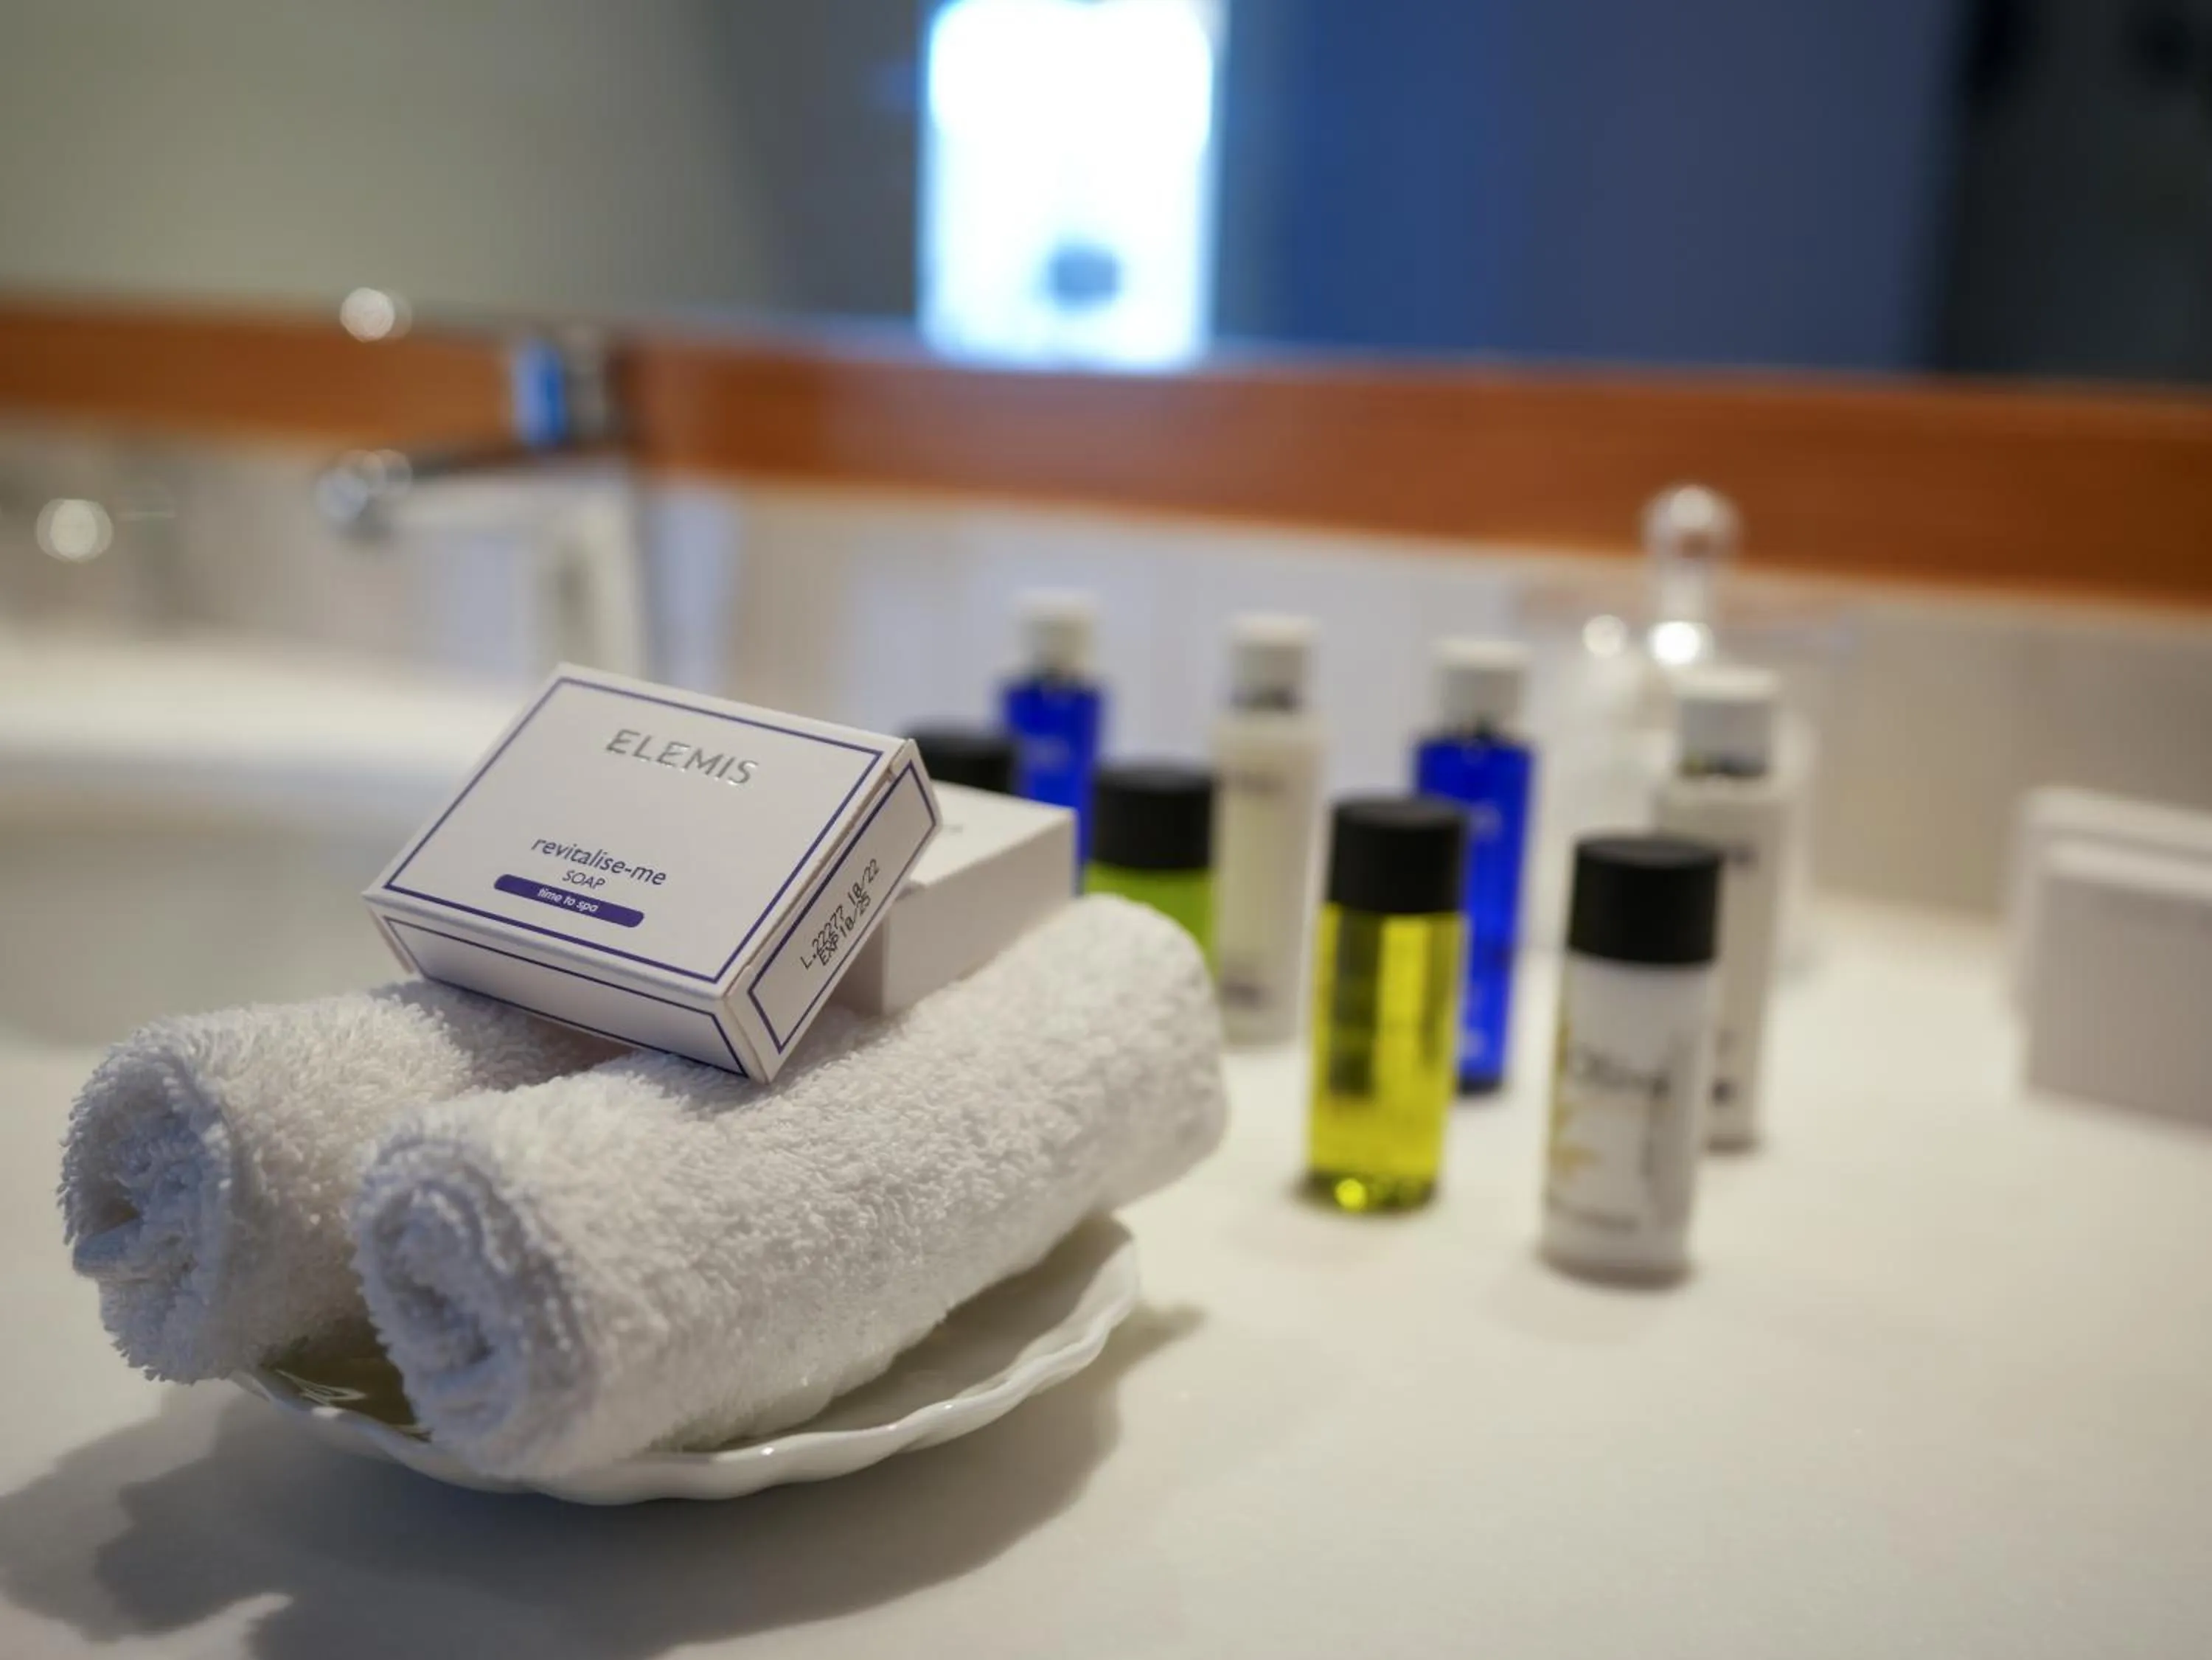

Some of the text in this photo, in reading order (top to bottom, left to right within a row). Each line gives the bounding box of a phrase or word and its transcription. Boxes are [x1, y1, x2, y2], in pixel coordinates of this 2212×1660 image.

[605, 729, 759, 784] ELEMIS
[530, 839, 667, 885] revitalise-me
[562, 870, 606, 890] SOAP
[537, 887, 599, 912] time to spa
